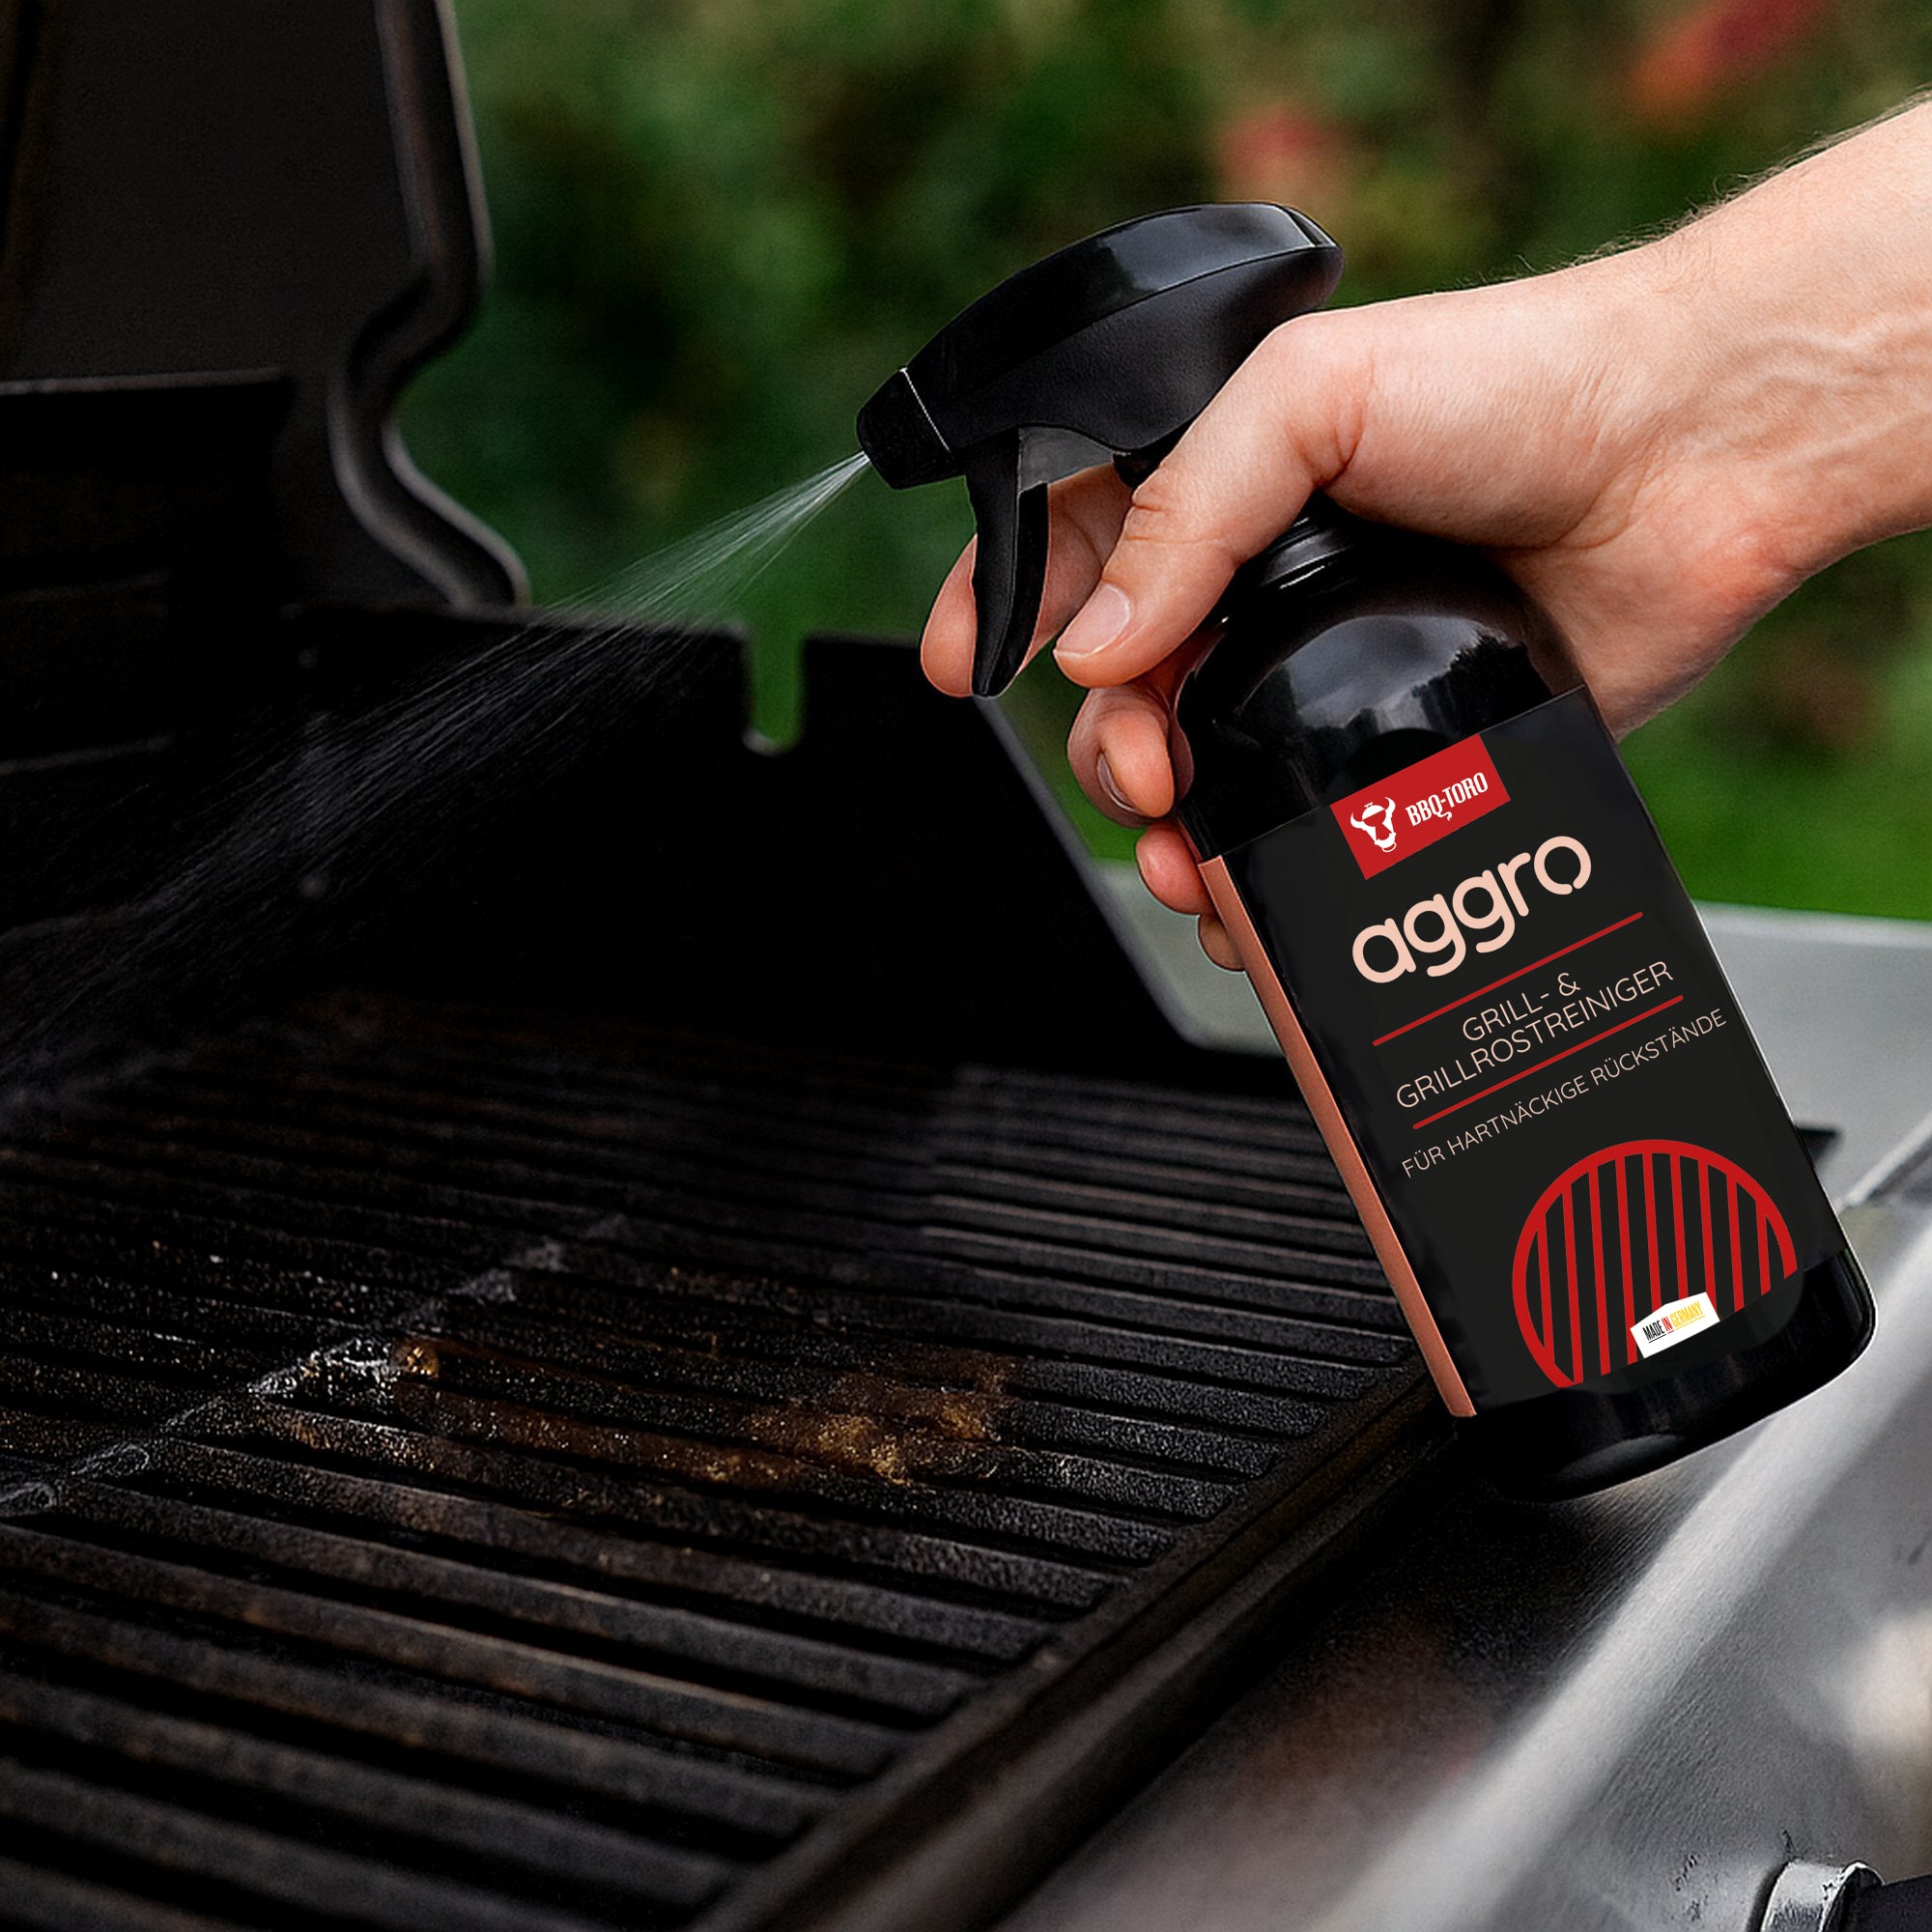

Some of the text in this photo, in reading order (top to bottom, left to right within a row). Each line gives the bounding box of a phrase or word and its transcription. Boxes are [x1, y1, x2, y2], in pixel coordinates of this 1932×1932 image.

[1405, 772, 1489, 826] BBQ-TORO
[1352, 836, 1592, 983] aggro
[1396, 961, 1674, 1108] GRILLROSTREINIGER
[1463, 972, 1581, 1040] GRILL- &
[1401, 1008, 1727, 1179] FÜR HARTNÄCKIGE RÜCKSTÄNDE
[1642, 1300, 1704, 1341] MADE IN GERMANY
